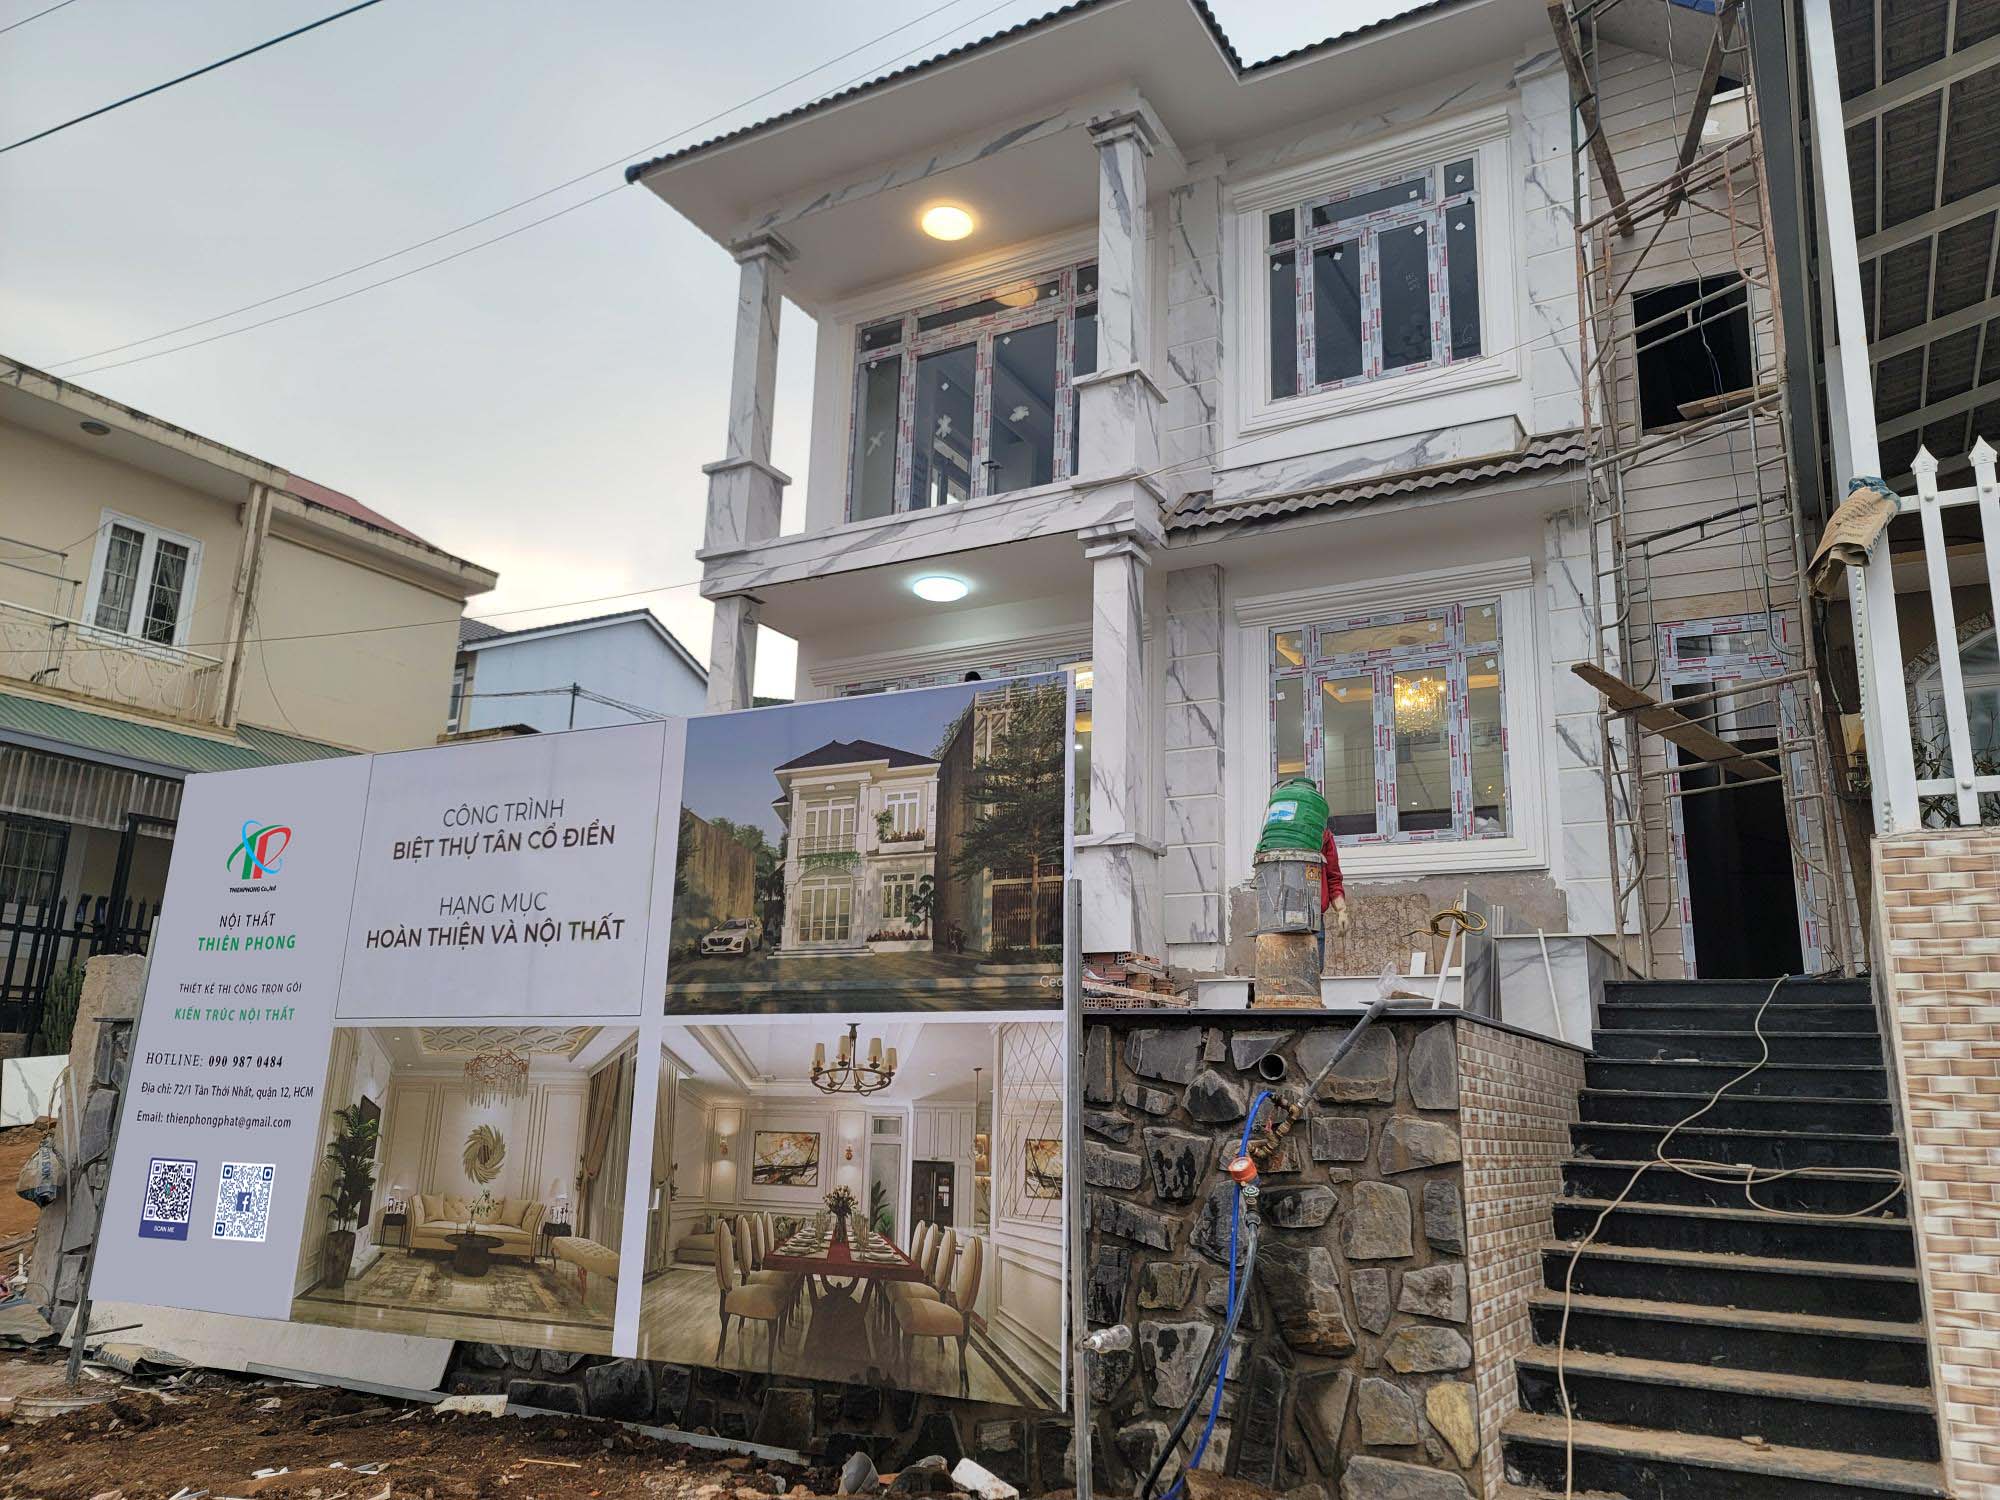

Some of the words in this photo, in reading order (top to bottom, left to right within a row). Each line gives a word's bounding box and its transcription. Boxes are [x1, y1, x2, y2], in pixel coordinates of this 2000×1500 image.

[443, 804, 499, 827] CÔNG
[505, 797, 564, 823] TRÌNH
[393, 836, 434, 863] BIỆT
[440, 832, 479, 860] THỰ
[483, 829, 522, 853] TÂN
[528, 822, 558, 850] CỔ
[563, 818, 616, 848] ĐIỂN
[439, 894, 495, 920] HẠNG
[501, 892, 548, 917] MỤC
[219, 912, 242, 930] NỘI
[245, 910, 276, 928] THẤT
[366, 924, 422, 949] HOÀN
[428, 921, 485, 950] THIỆN
[491, 919, 518, 944] VÀ
[524, 917, 562, 947] NỘI
[568, 912, 626, 942] THẤT
[198, 934, 240, 951] THIÊN
[245, 934, 296, 951] PHONG
[218, 984, 232, 995] THI
[233, 983, 258, 995] CÔNG
[261, 982, 284, 997] TRỌN
[174, 1006, 201, 1021] KIẾN
[205, 1007, 235, 1022] TRÚC
[239, 1008, 261, 1024] NỘI
[265, 1005, 296, 1021] THẤT
[145, 1052, 204, 1068] HOTLINE:
[208, 1055, 228, 1068] 090
[232, 1055, 253, 1068] 987
[256, 1055, 283, 1068] 0484
[141, 1081, 155, 1095] Địa
[173, 1083, 192, 1096] 72/1
[280, 1086, 291, 1099] 12,
[294, 1085, 314, 1098] HCM
[136, 1110, 164, 1123] Email:
[166, 1112, 292, 1130] thienphongphat@gmail.com
